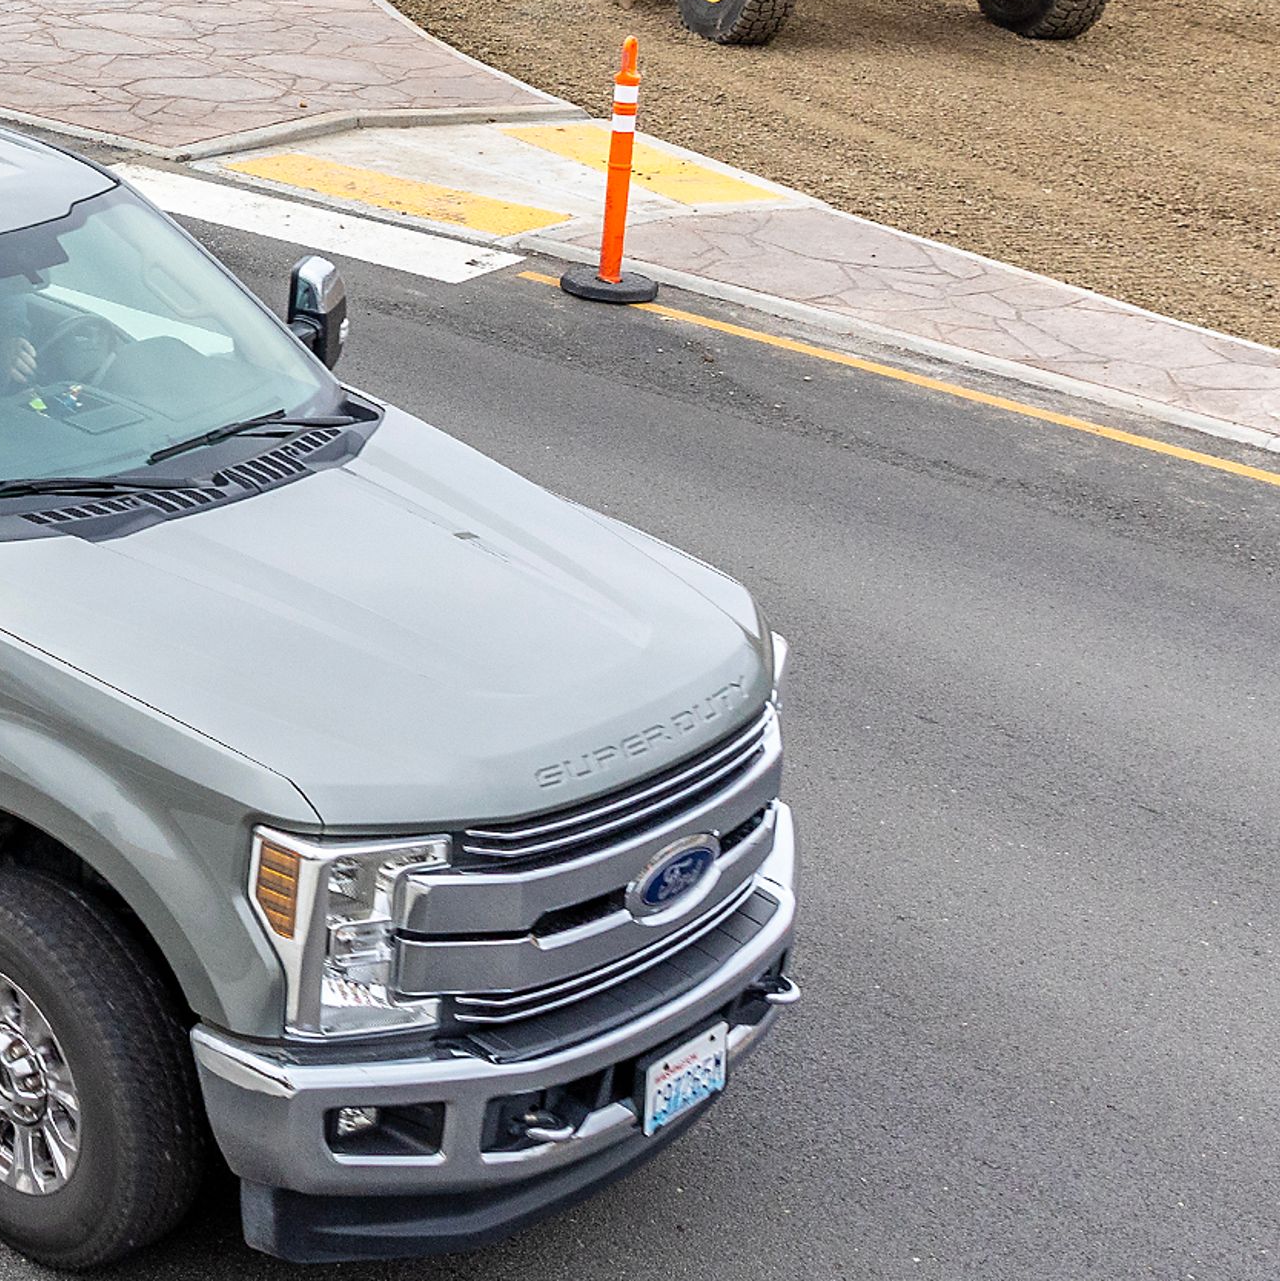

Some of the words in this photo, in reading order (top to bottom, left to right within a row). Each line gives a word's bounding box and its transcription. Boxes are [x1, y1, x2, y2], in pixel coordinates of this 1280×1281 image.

[534, 723, 672, 789] SUPER
[669, 674, 750, 737] DUTY
[657, 857, 704, 900] Ford
